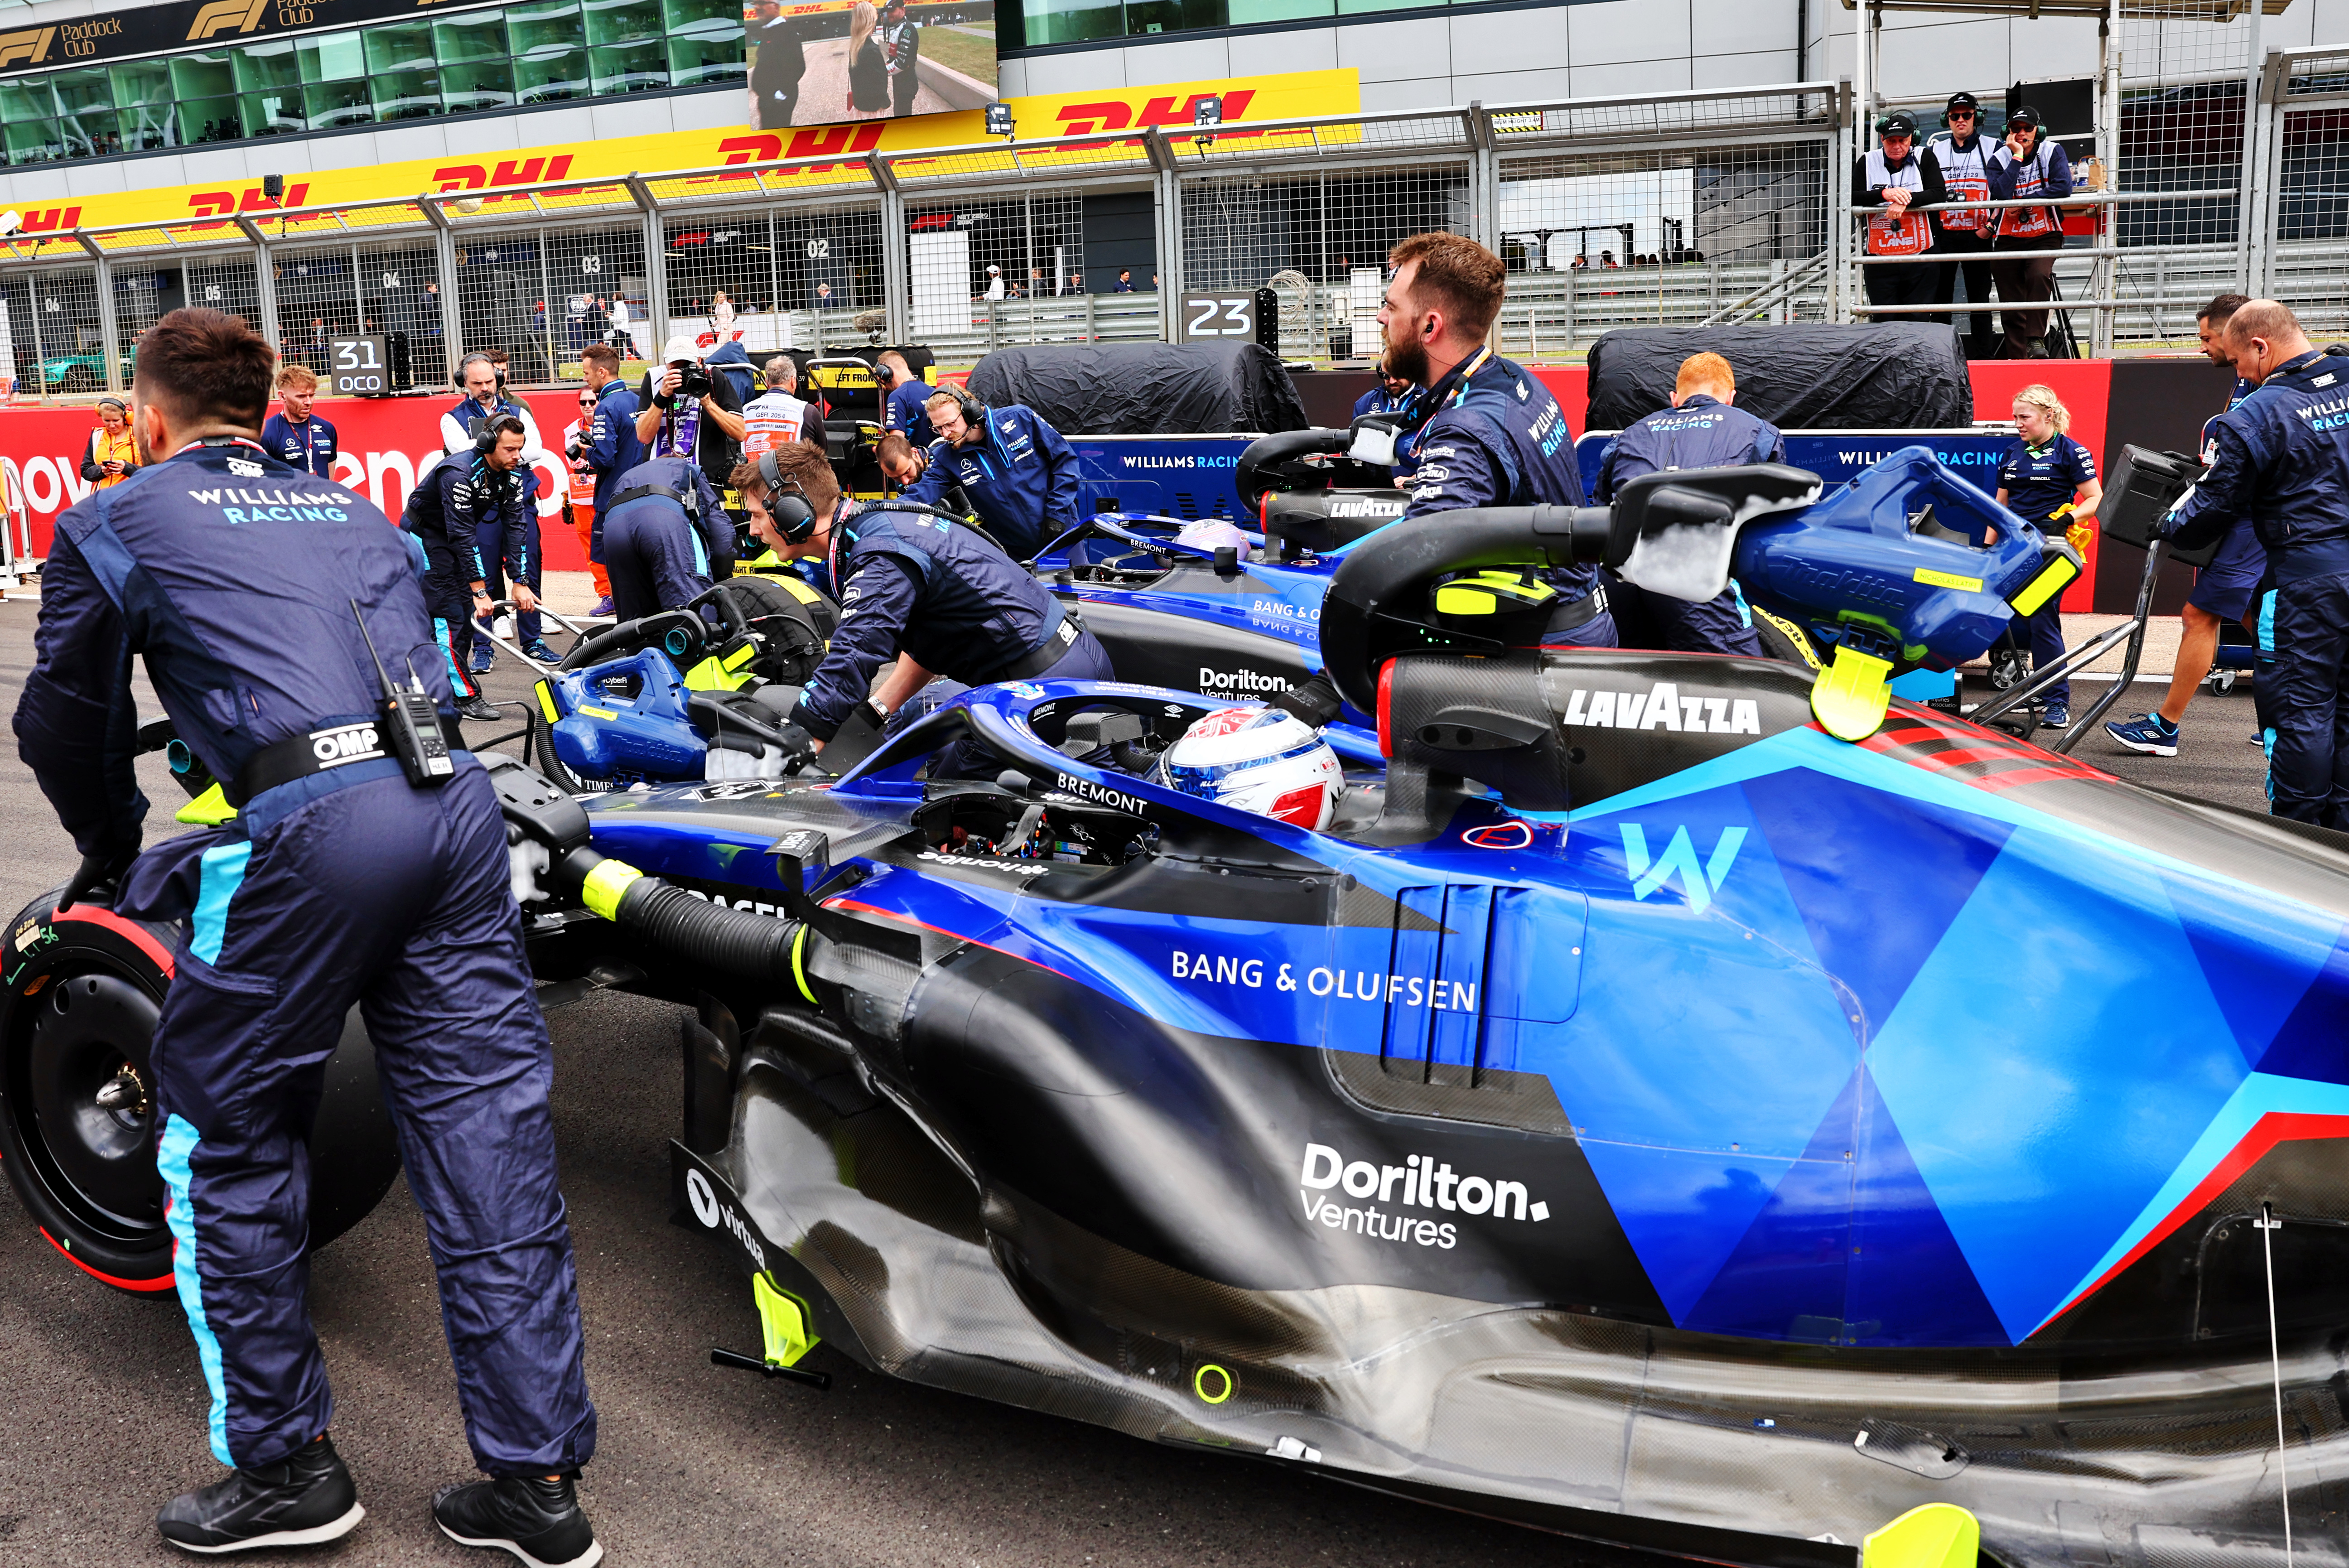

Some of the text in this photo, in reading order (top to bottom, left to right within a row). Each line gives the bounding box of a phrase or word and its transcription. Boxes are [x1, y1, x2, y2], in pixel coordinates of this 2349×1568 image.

[279, 6, 314, 26] Club
[793, 5, 825, 14] DHL
[61, 18, 122, 41] Paddock
[64, 39, 96, 57] Club
[1056, 90, 1267, 151] DHL
[717, 123, 894, 181] DHL
[432, 154, 583, 207] DHL
[188, 183, 319, 232] DHL
[1946, 210, 1967, 219] PIT
[0, 206, 82, 248] HL
[1942, 218, 1973, 227] LANE
[2011, 219, 2045, 233] LANE
[1878, 236, 1914, 247] LANE
[1882, 228, 1905, 238] PIT
[807, 239, 828, 258] 02
[582, 256, 601, 273] 03
[383, 272, 400, 288] 04
[206, 285, 221, 301] 05
[45, 298, 60, 312] 06
[1188, 299, 1251, 335] 23
[334, 341, 381, 370] 31
[339, 375, 381, 391] OCO
[835, 374, 874, 382] LEFT FRON
[2313, 374, 2335, 386] OMP
[1647, 414, 1724, 426] WILLIAMS
[1651, 420, 1712, 432] RACING
[1007, 434, 1028, 449] WILLIAMS
[1010, 439, 1028, 452] RACING
[1541, 418, 1566, 458] RACING
[746, 442, 771, 452] 2022
[1014, 448, 1034, 462] DURACELL
[1426, 446, 1456, 456] honibe
[1124, 455, 1240, 468] WILLIAMS RACIN
[1938, 451, 2004, 465] RACIN
[228, 461, 265, 478] OMP
[188, 488, 352, 505] WILLIAMS
[223, 506, 348, 524] RACING
[1331, 497, 1403, 518] LAVAZZA
[1130, 538, 1167, 555] BREMONT
[1920, 572, 1977, 589] NICHOLAS LATIFI
[1253, 600, 1293, 616] BANG
[1297, 607, 1307, 618] &
[1200, 667, 1295, 692] Dorilton.
[1094, 685, 1136, 695] DOWNLOAD
[1137, 688, 1156, 696] THE
[1033, 703, 1056, 718] BREMONT
[1563, 682, 1761, 734] LAVAZZA
[313, 729, 378, 760] OMP
[1058, 773, 1147, 815] BREMONT
[777, 831, 811, 849] URSA
[1100, 852, 1114, 866] PULL
[1172, 951, 1476, 1011] BANG & OLUFSEN
[1301, 1142, 1550, 1222] Dorilton.
[1300, 1189, 1457, 1250] Ventures
